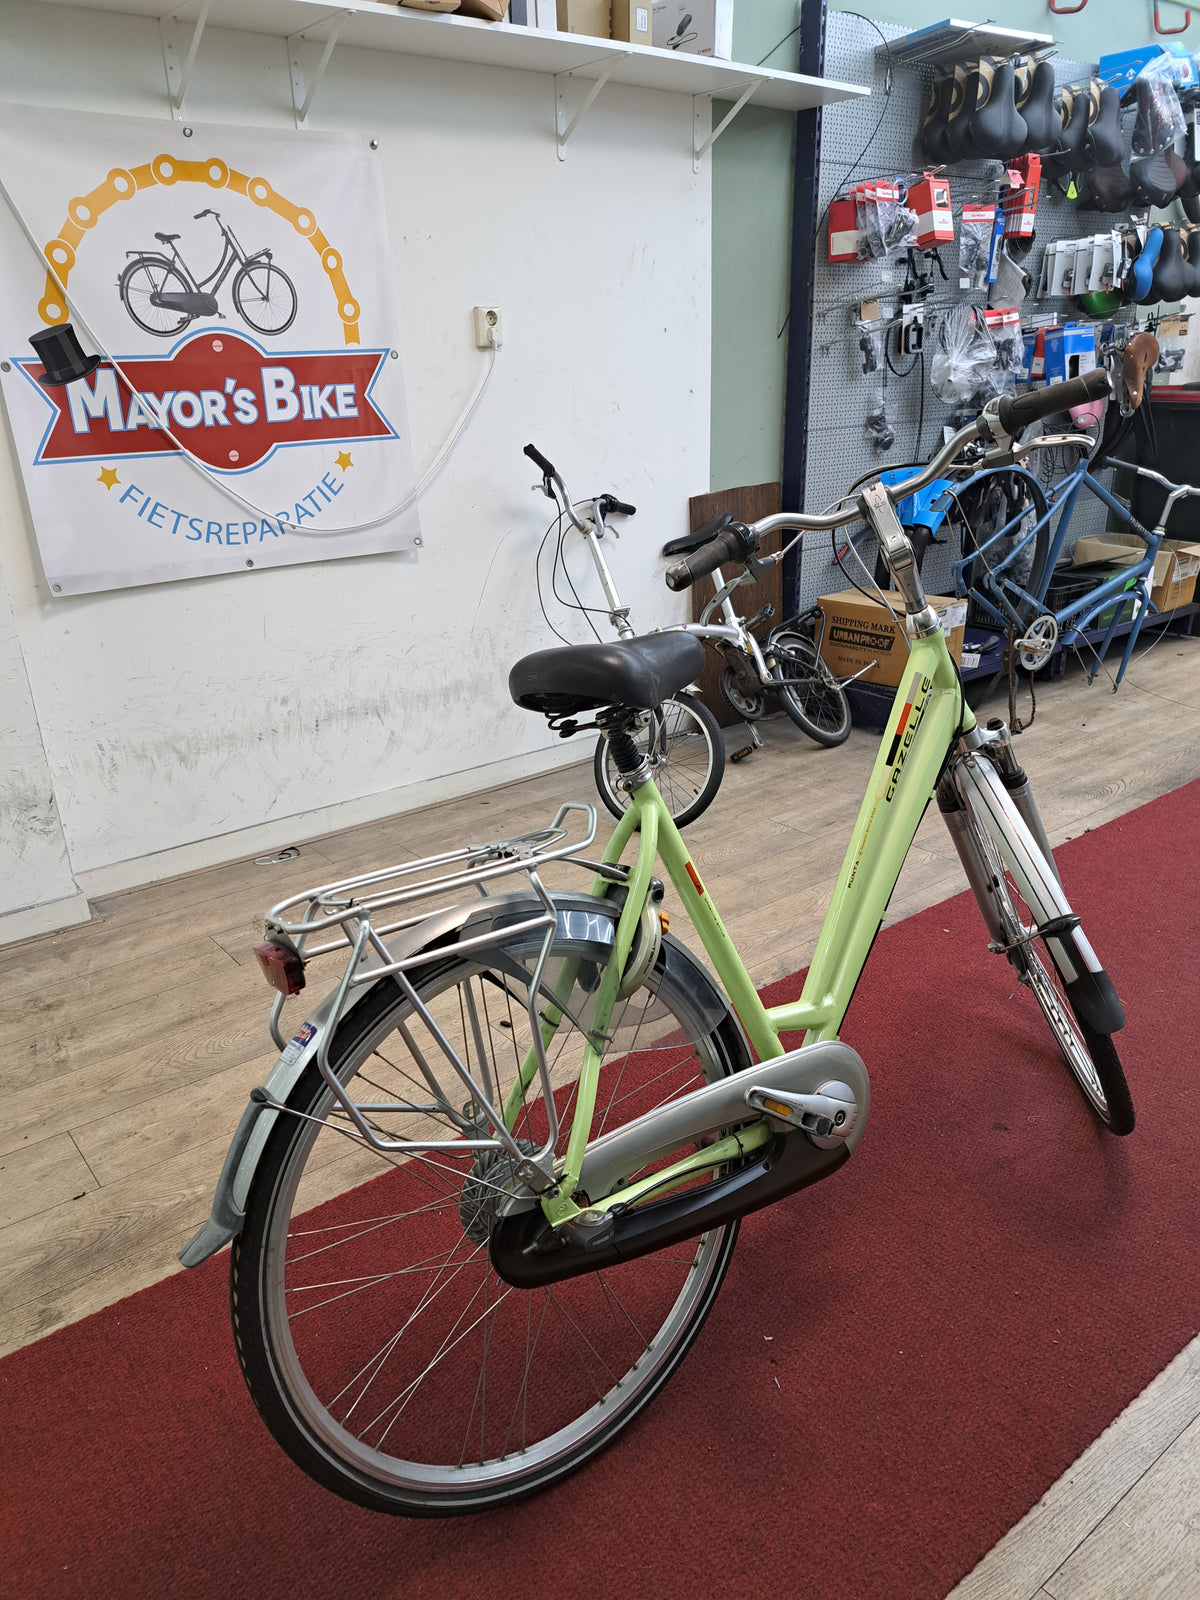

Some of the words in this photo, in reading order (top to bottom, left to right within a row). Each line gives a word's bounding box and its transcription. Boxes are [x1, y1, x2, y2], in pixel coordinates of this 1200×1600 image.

[65, 368, 259, 434] MAYOR'S
[260, 366, 360, 424] BIKE
[119, 472, 345, 545] FIETSREPARATIE
[832, 615, 869, 630] SHIPPING
[870, 622, 895, 634] MARK
[832, 628, 891, 649] URBANPROOF
[837, 655, 853, 664] MADE
[885, 676, 931, 803] GAZELLE
[847, 860, 860, 889] PUNTA
